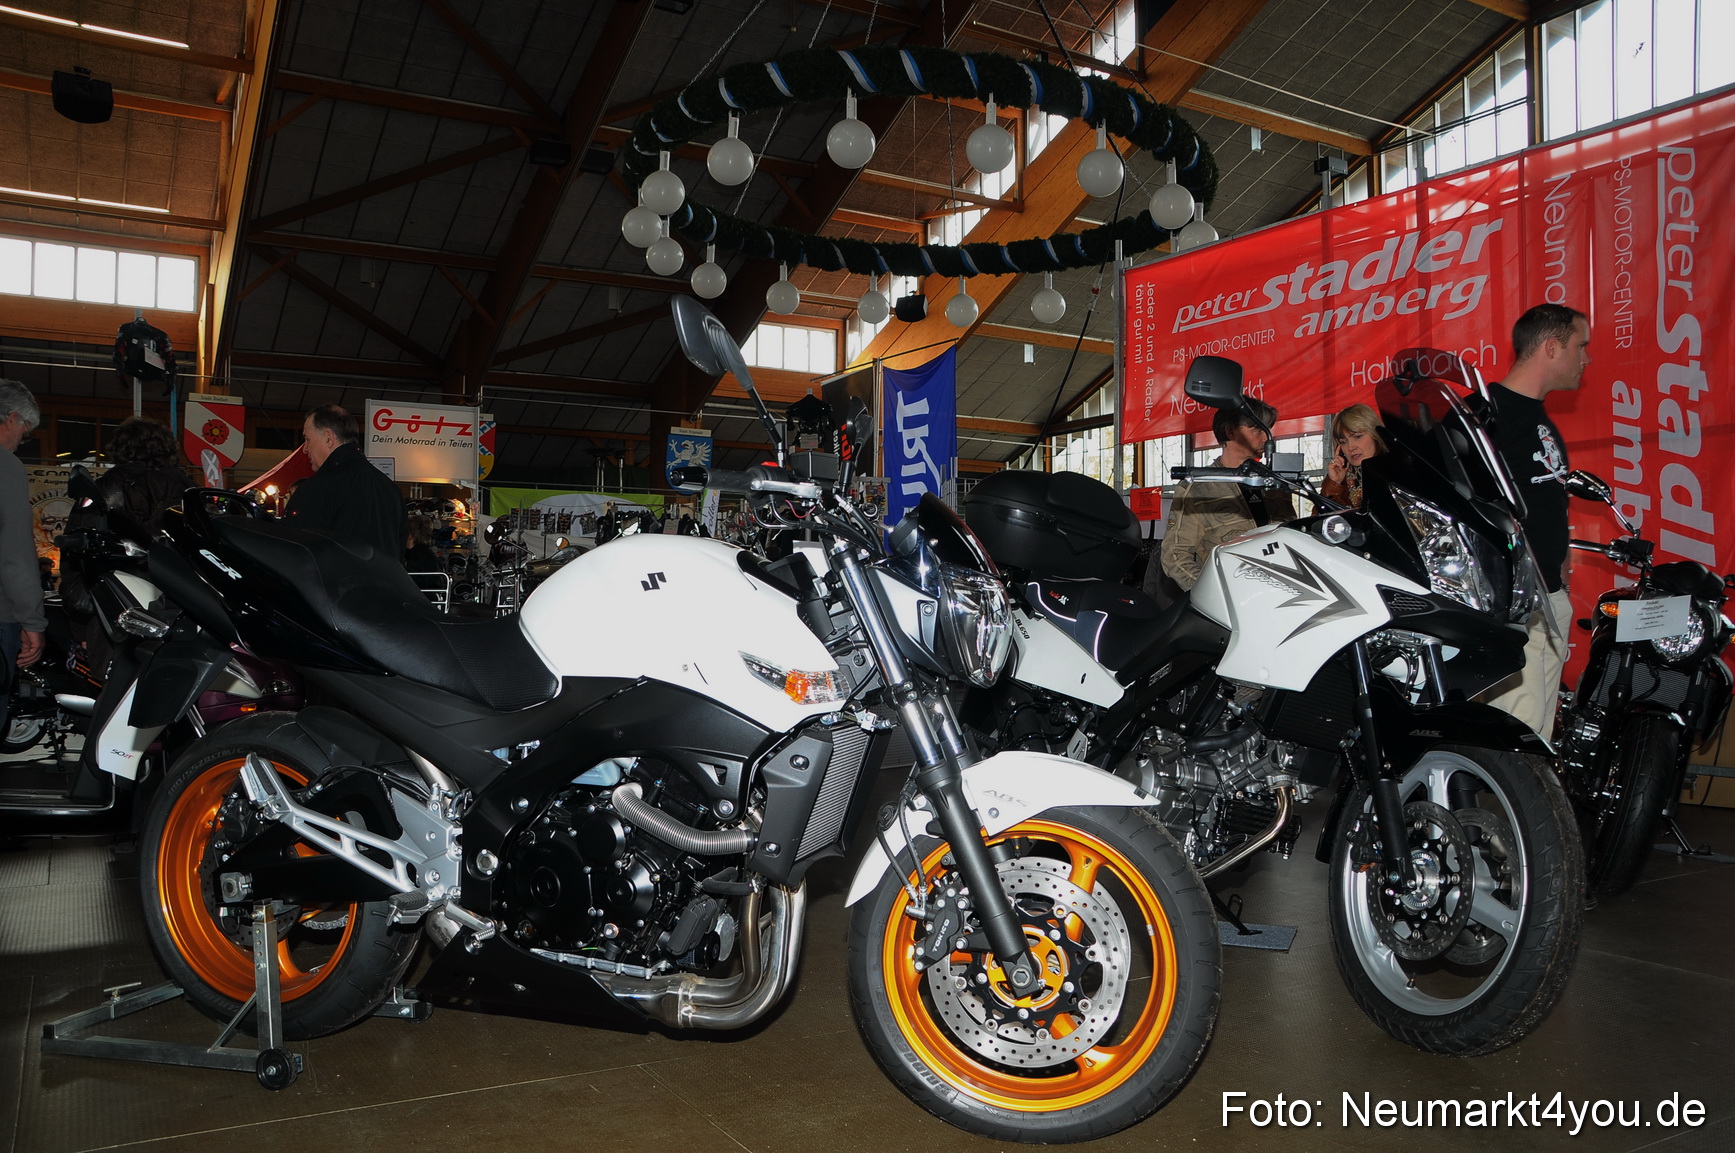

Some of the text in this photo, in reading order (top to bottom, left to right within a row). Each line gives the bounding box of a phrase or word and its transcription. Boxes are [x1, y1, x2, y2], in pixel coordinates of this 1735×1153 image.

[1543, 174, 1571, 305] Neuma
[1612, 158, 1634, 350] PS-MOTOR-CENTER
[1135, 284, 1144, 315] fährt
[1172, 287, 1257, 334] peter
[1293, 273, 1488, 338] amberg
[1133, 318, 1143, 341] gut
[1172, 328, 1276, 363] PS-MOTOR-CENTER
[1134, 343, 1143, 364] mit
[1144, 281, 1156, 422] Jeder 2 und 4 Radler
[1656, 146, 1718, 568] peter stadl
[1170, 379, 1264, 417] Neurkt
[371, 434, 474, 449] Dein Motorrad in Teilen
[982, 789, 1030, 808] ABS
[932, 918, 950, 952] TOKICO
